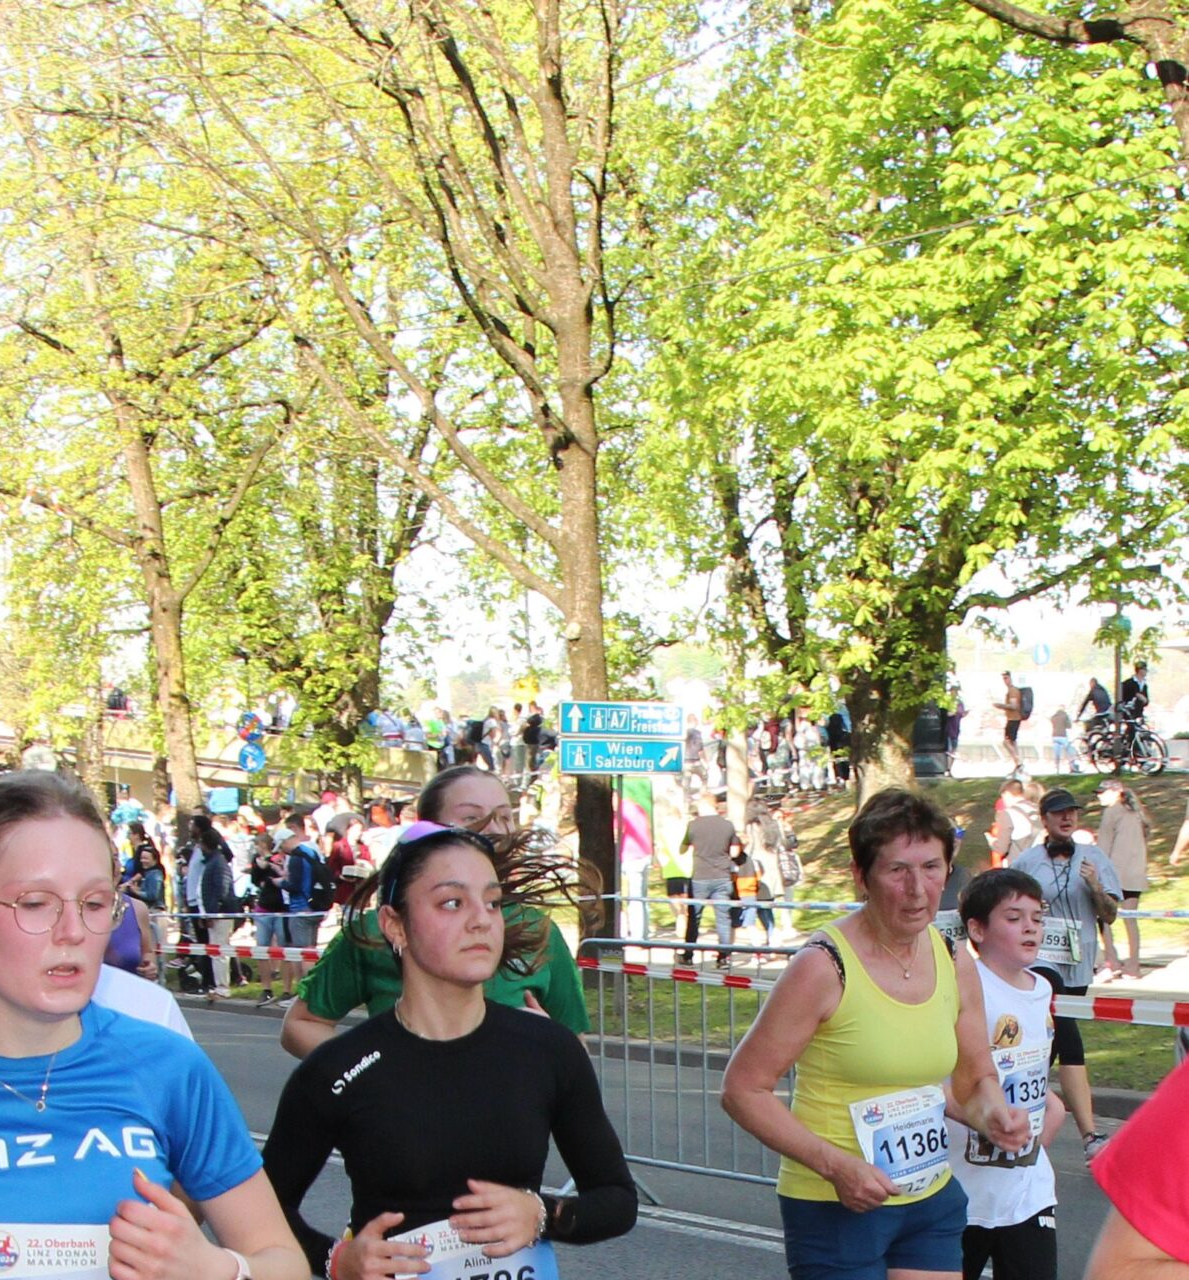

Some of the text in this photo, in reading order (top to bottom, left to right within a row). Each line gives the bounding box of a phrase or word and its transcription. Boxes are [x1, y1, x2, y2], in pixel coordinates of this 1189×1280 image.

[610, 711, 628, 728] A7
[606, 742, 643, 755] Wien
[595, 756, 654, 771] Salzburg
[343, 1050, 381, 1082] Sondico
[892, 1116, 934, 1132] Heidemarie
[73, 1126, 157, 1160] AG
[27, 1239, 96, 1248] 22. Oberbank
[464, 1257, 492, 1269] Alina
